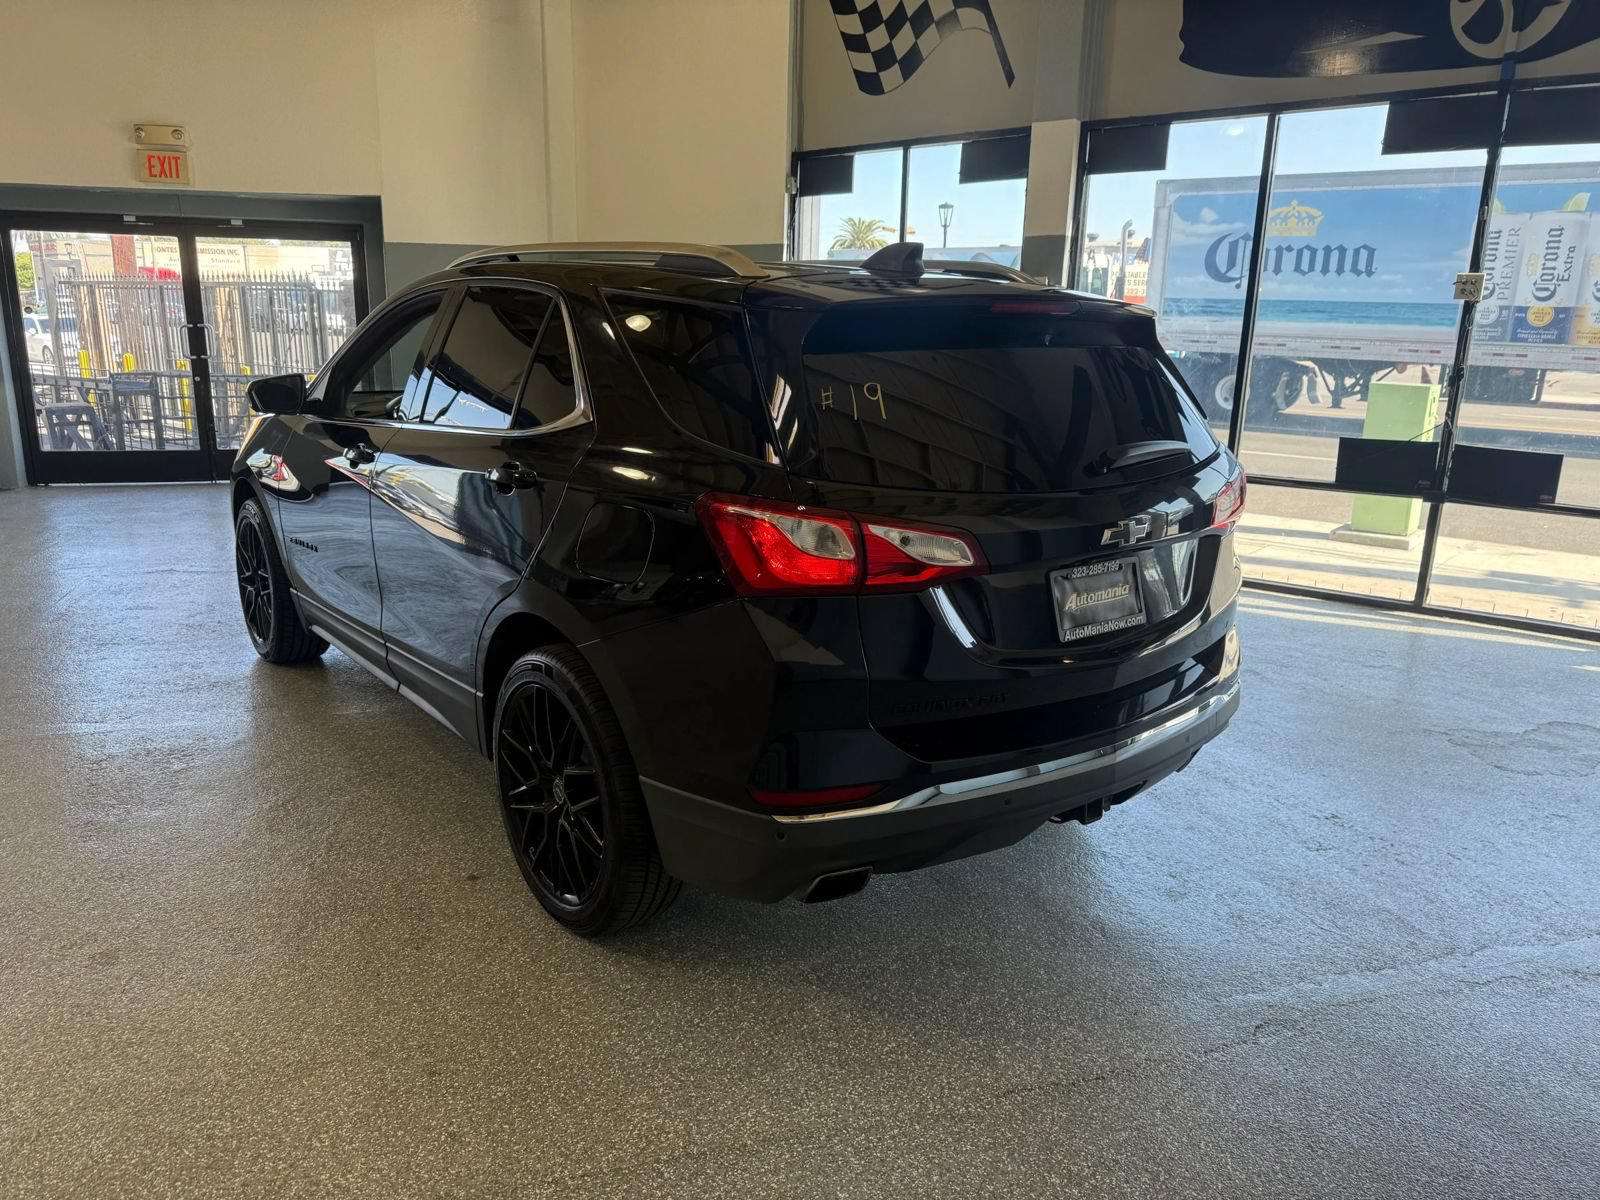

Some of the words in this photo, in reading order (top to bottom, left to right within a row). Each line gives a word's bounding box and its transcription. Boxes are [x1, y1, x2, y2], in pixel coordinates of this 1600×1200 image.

[147, 154, 181, 179] EXIT
[199, 247, 226, 255] MISSION
[1496, 227, 1521, 300] PREMIER
[1531, 225, 1565, 302] Corona
[1556, 245, 1577, 283] Extra
[1064, 583, 1130, 611] Automania
[1064, 615, 1144, 641] AutoManiaNow.com
